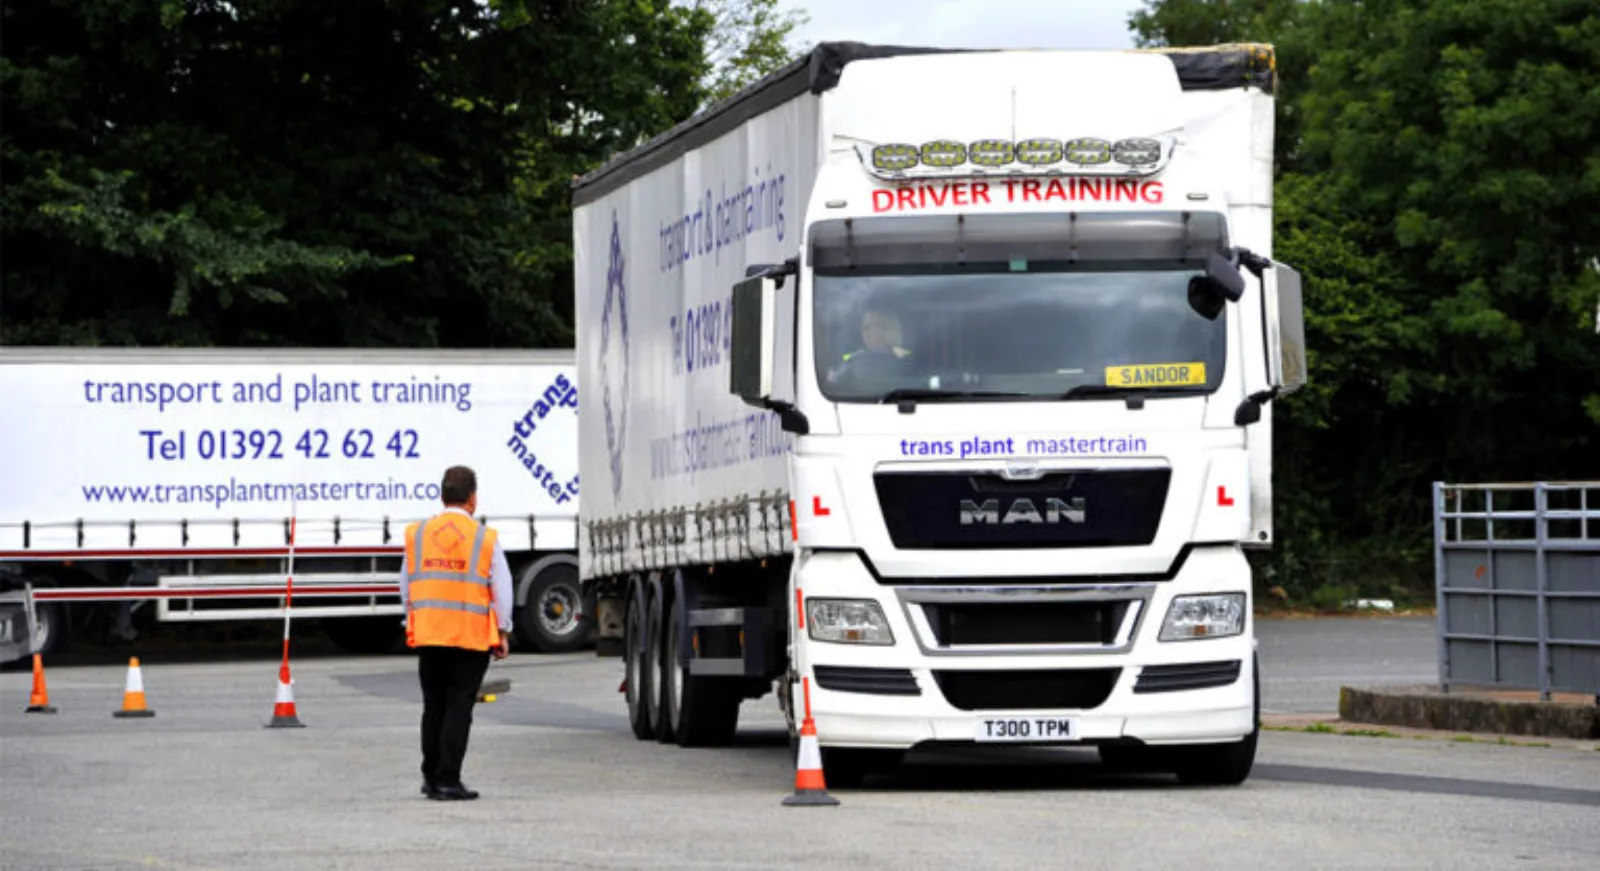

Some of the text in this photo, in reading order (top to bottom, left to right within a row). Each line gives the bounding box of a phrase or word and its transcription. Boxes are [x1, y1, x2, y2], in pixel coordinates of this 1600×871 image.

[871, 177, 1164, 213] DRIVER TRAINING
[1120, 366, 1190, 384] SANDOR
[83, 375, 471, 412] transport and plant training
[513, 373, 571, 439] trans
[139, 428, 421, 460] Tel 01392 42 62 42
[899, 435, 1147, 458] trans plant mastertrain
[506, 434, 571, 504] master
[82, 476, 441, 508] www.transplantmastertrain.co
[812, 496, 831, 516] L
[1217, 485, 1235, 506] L
[960, 497, 1085, 524] MAN
[984, 719, 1070, 737] T300 TPM
